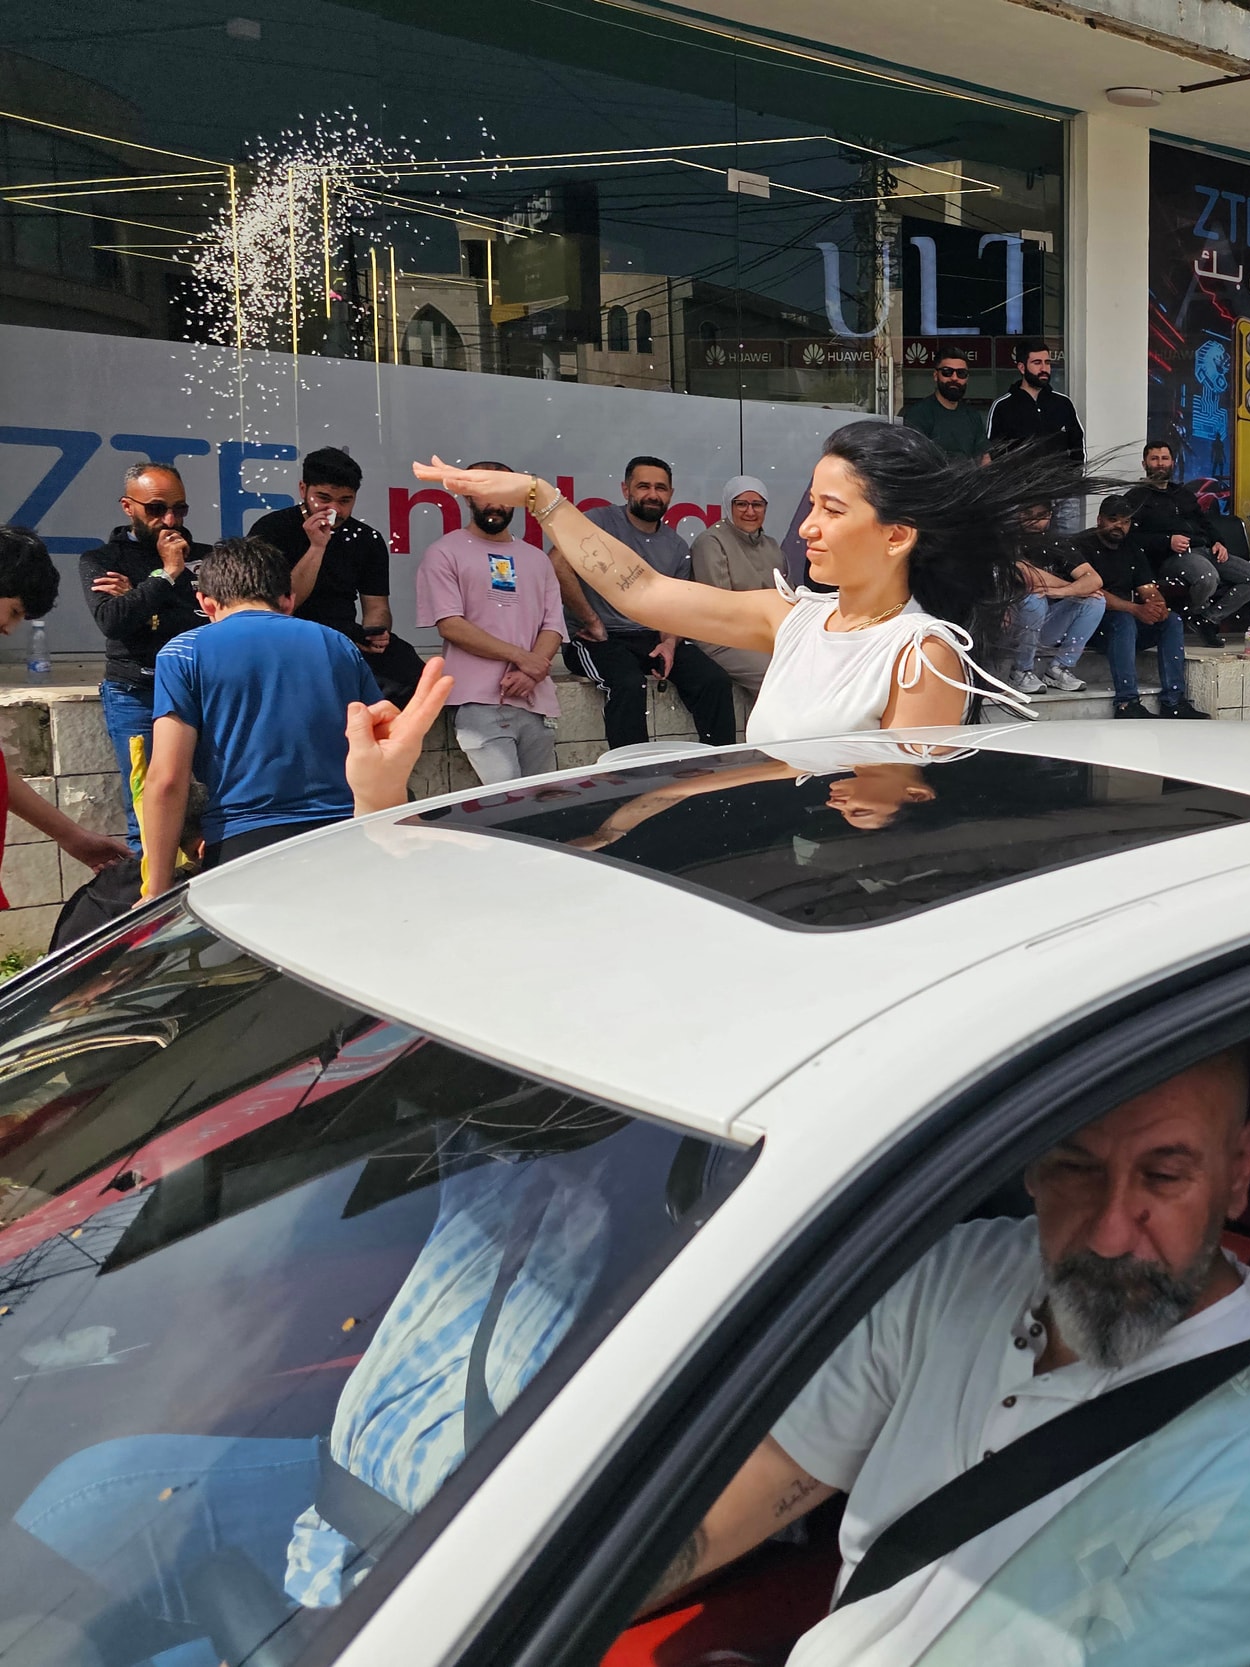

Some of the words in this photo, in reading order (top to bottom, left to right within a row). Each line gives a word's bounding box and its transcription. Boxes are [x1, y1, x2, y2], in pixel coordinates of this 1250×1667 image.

[1194, 250, 1243, 290] بك
[729, 352, 772, 363] HUAWEI
[828, 351, 873, 362] HUAWEI
